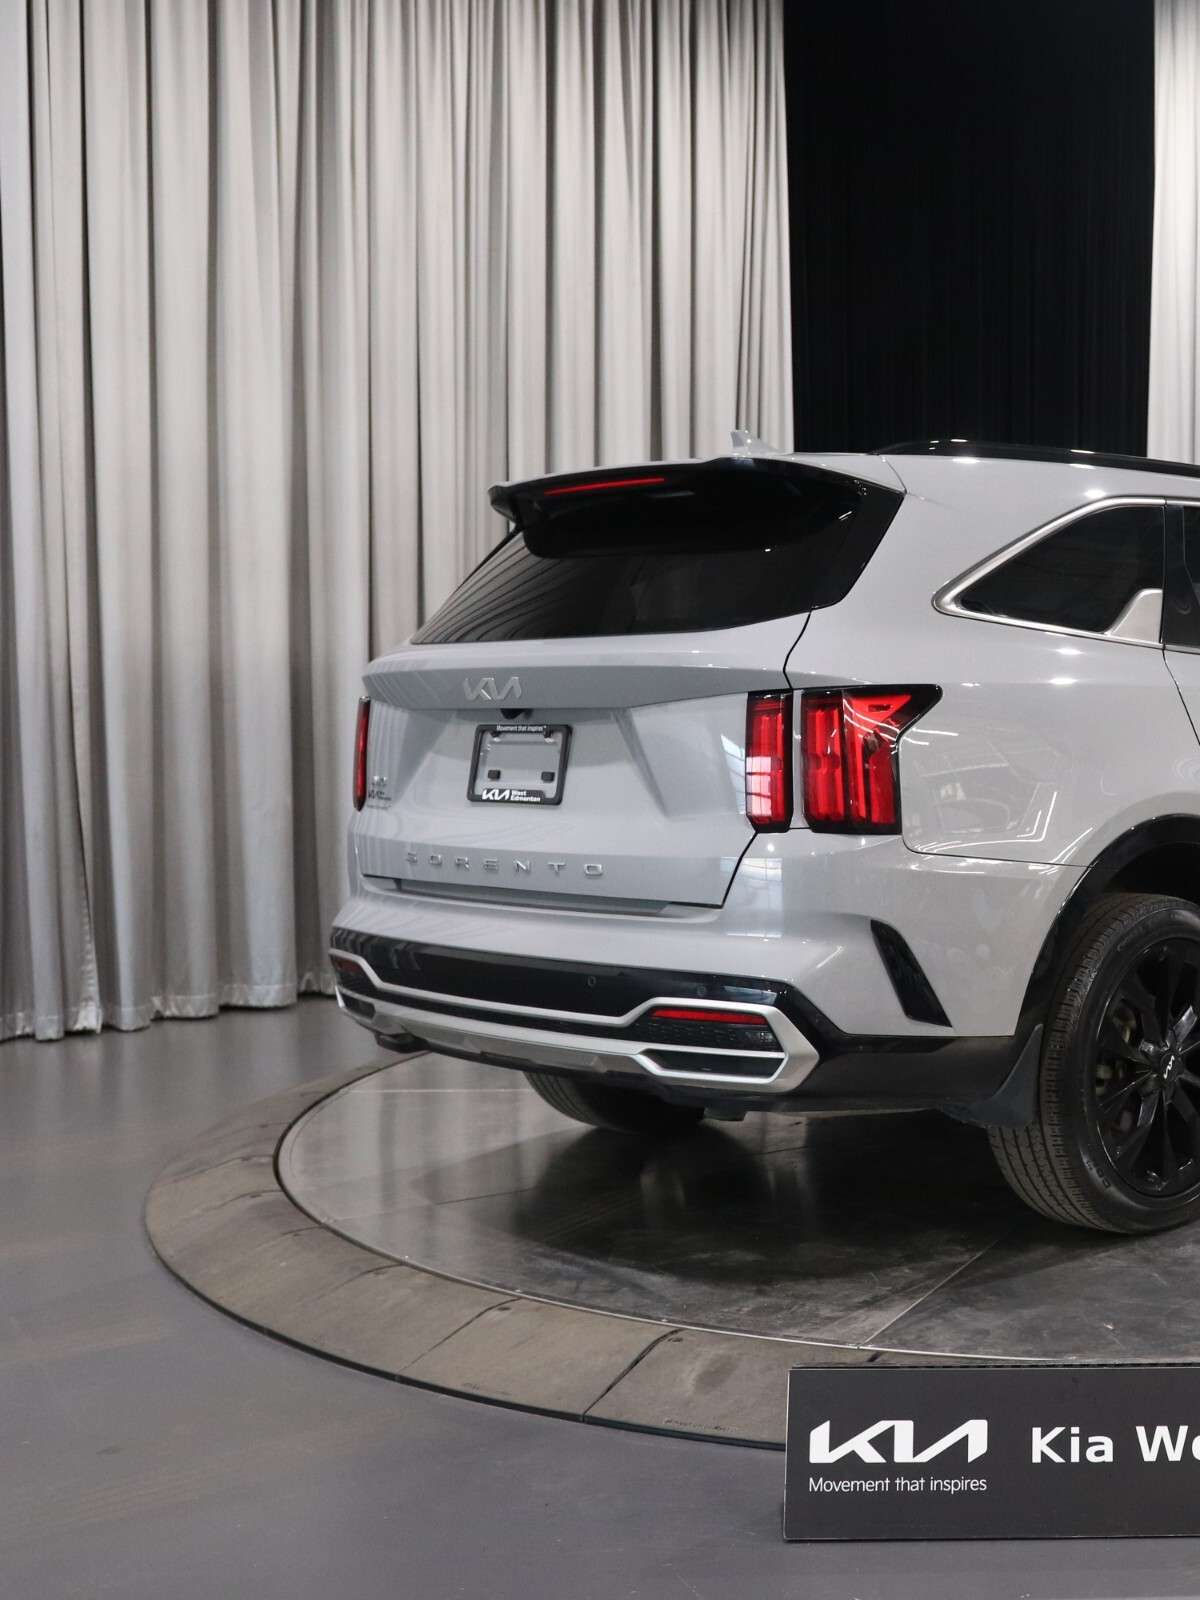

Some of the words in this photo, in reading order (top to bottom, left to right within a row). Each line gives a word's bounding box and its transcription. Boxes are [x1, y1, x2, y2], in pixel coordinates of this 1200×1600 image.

[463, 677, 521, 700] KIA
[482, 788, 510, 800] KIA
[406, 852, 604, 876] SORENTO
[809, 1419, 988, 1463] KIA
[1031, 1427, 1114, 1463] Kia
[809, 1476, 890, 1492] Movement
[894, 1476, 925, 1492] that
[930, 1475, 988, 1495] inspires
